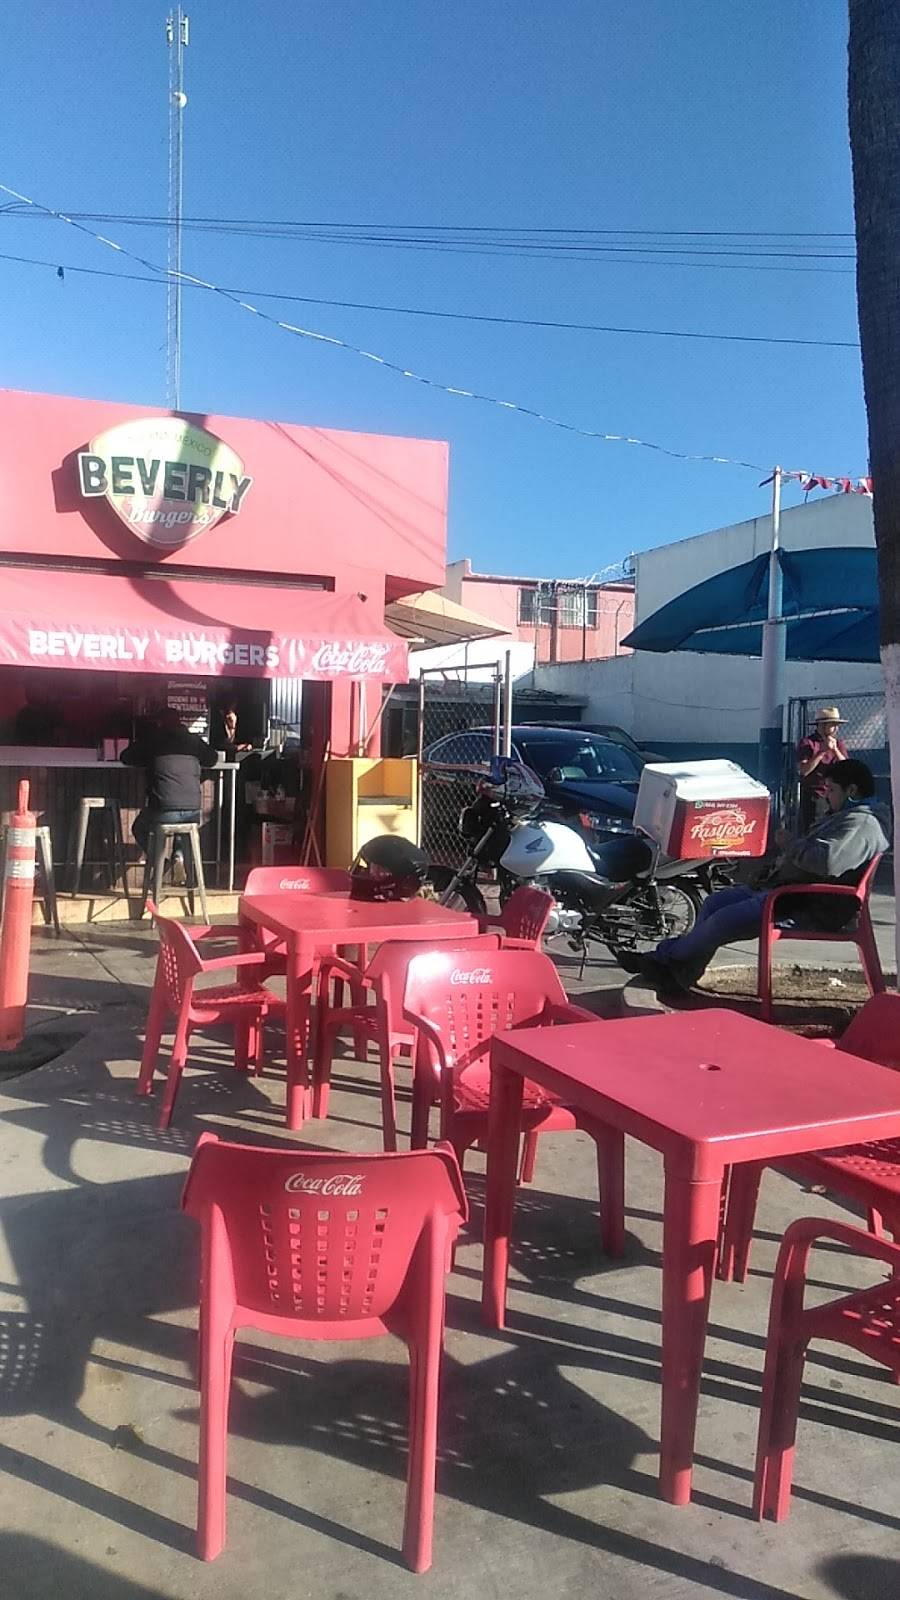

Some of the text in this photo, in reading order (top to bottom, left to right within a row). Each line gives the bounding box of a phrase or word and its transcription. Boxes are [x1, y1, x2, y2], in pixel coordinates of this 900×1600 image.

[79, 453, 253, 513] BEVERLY
[28, 629, 280, 668] BEVERLY BURGERS
[312, 642, 390, 675] Coca-Cola
[450, 968, 493, 985] Coca-Cola
[284, 1172, 366, 1196] Coca-Cola
